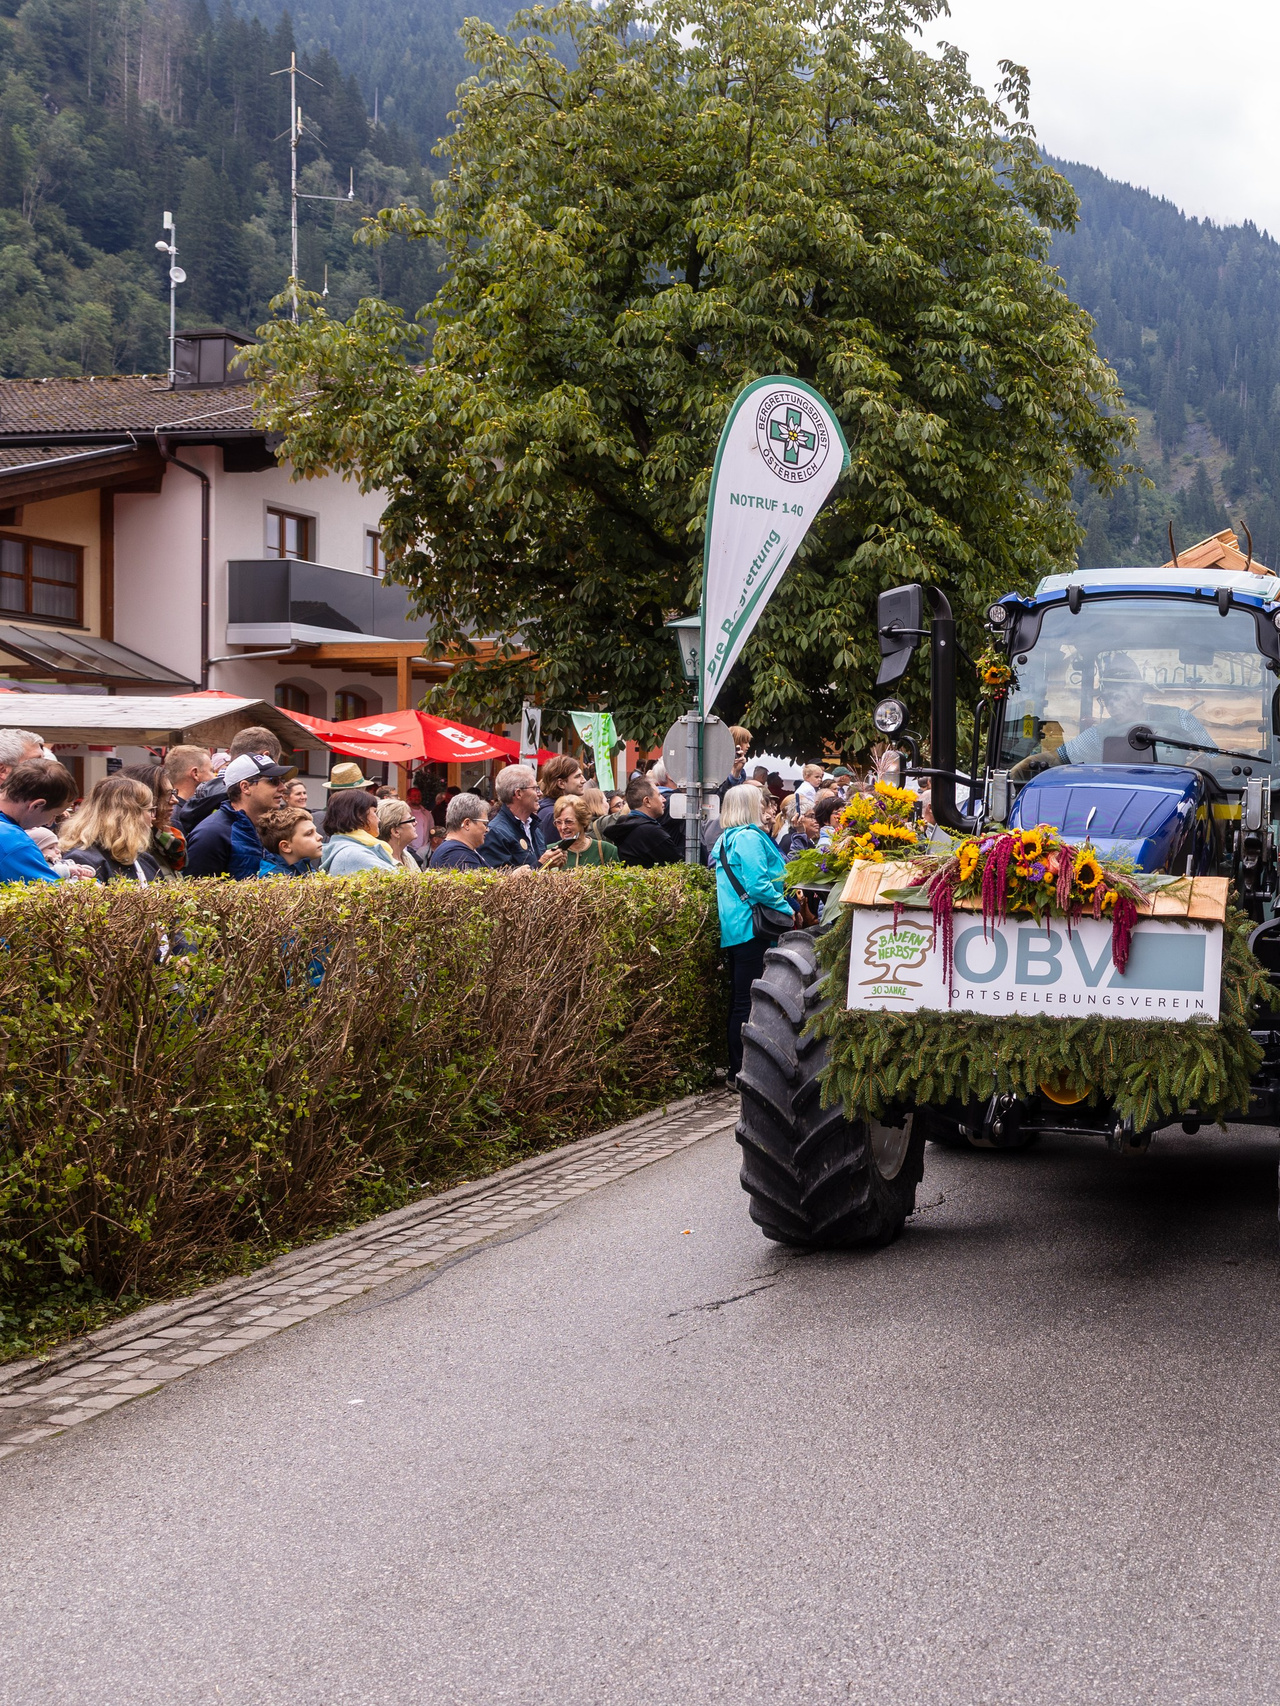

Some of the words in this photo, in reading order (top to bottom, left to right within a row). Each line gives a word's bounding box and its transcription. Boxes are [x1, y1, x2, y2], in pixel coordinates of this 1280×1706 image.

[758, 393, 828, 450] BERGRETTUNGSDIENST
[762, 448, 818, 481] ÖSTERREICH
[729, 492, 779, 512] NOTRUF
[782, 502, 804, 517] 140
[878, 930, 927, 948] BAUERN
[877, 944, 920, 961] HERBST
[953, 925, 1117, 988] OBV
[871, 985, 883, 995] 30
[884, 986, 908, 996] JAHRE
[951, 988, 1205, 1010] ORTSBELEBUNGSVEREIN
